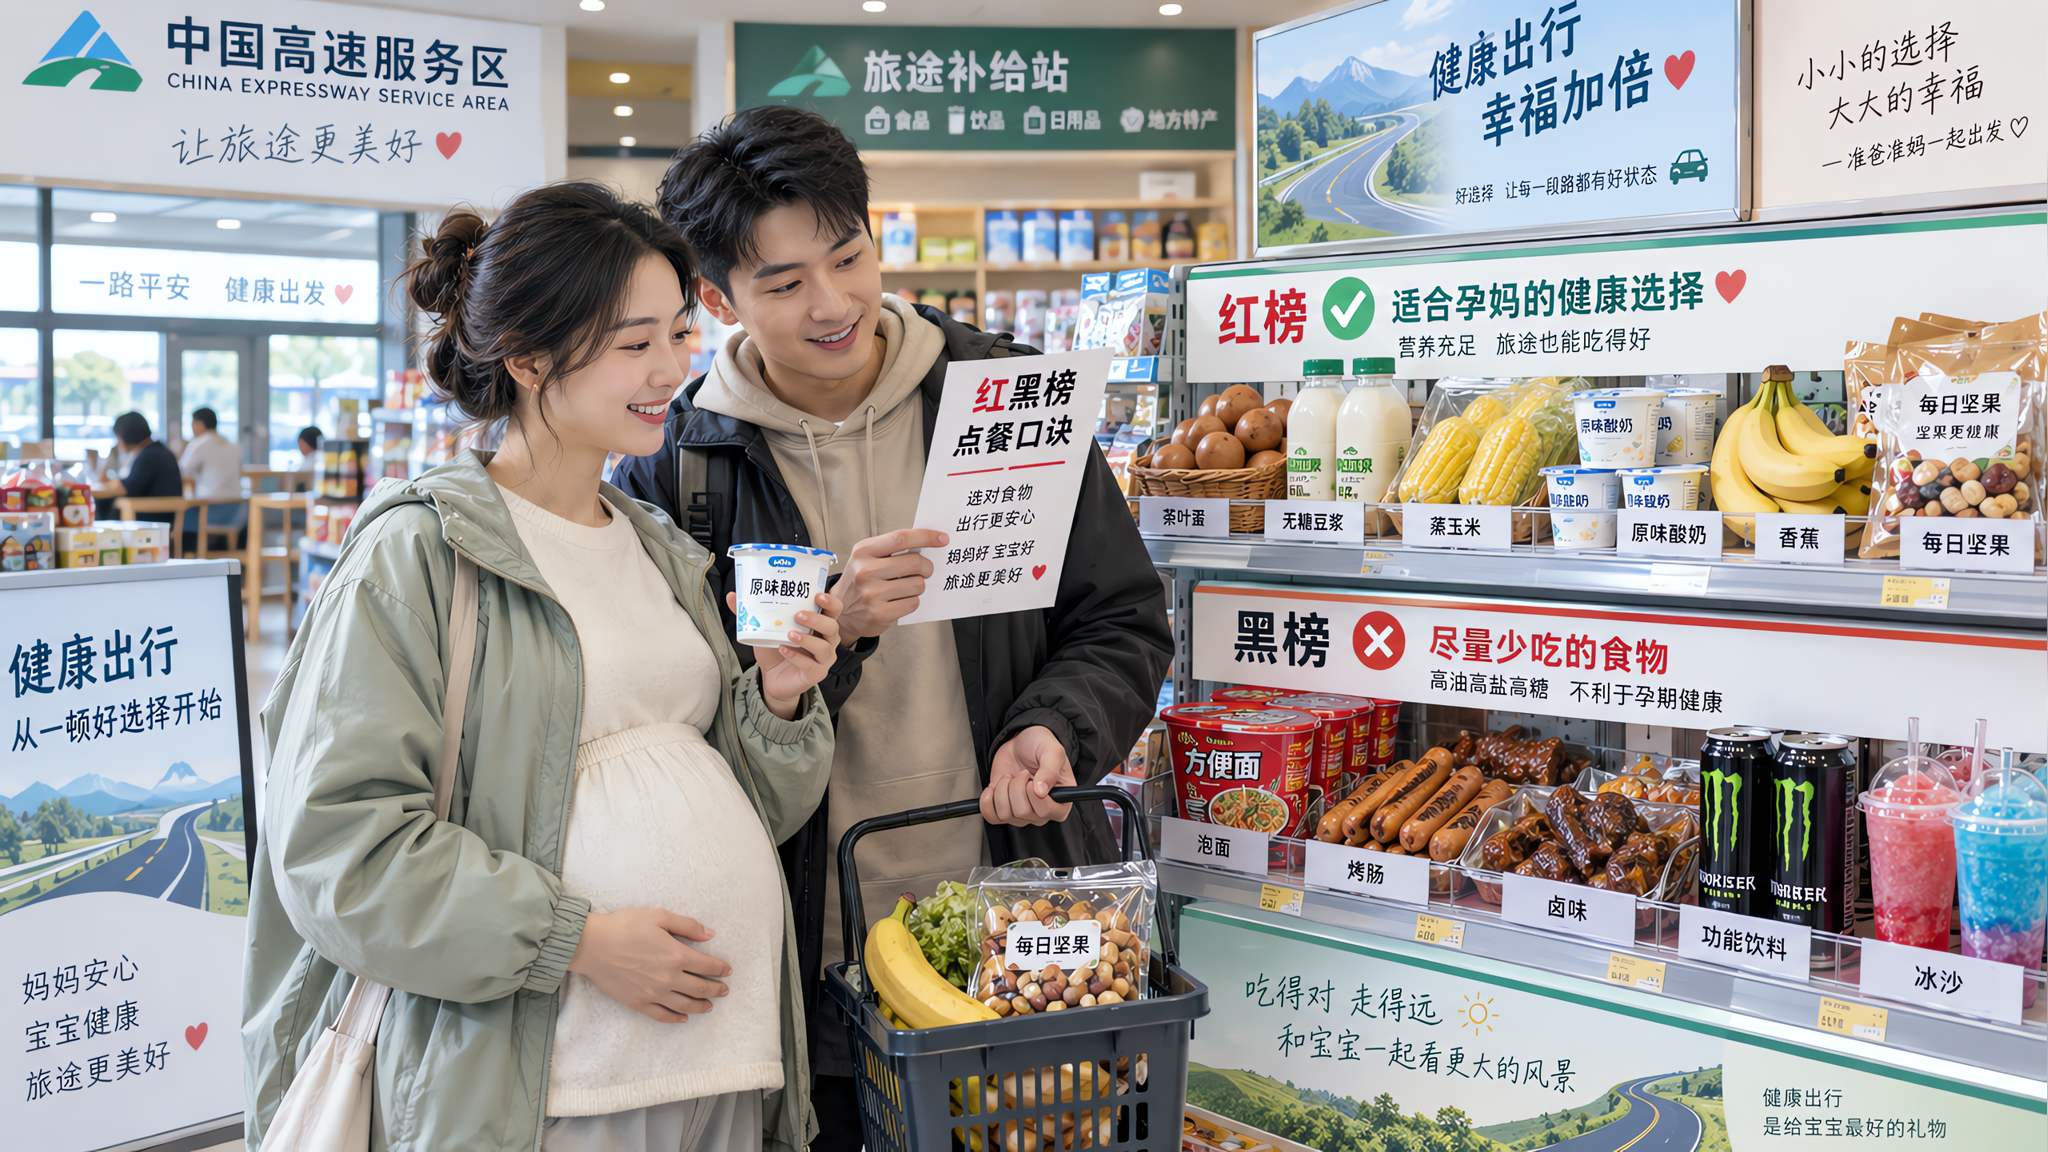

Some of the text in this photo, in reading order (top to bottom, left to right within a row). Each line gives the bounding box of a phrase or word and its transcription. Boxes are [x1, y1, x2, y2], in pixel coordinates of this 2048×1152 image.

[167, 15, 509, 89] 中国高速服务区
[1428, 0, 1582, 101] 健康出行
[1797, 20, 1960, 91] 小小的选择
[863, 50, 1070, 93] 旅途补给站
[168, 73, 508, 111] CHINA EXPRESSWAY SERVICE AREA
[1481, 48, 1653, 148] 幸福加倍
[1828, 65, 1985, 130] 大大的幸福
[894, 109, 1219, 130] 食品 饮品 日用品 地方特产
[172, 123, 422, 165] 让旅途更美好
[1506, 165, 1657, 198] 让每一段路都有好状态
[80, 271, 324, 305] 一路平安 健康出发
[1219, 271, 1703, 344] 红榜 适合孕妈的健康选择
[1399, 328, 1650, 358] 营养充足 旅途也能吃得好
[973, 369, 1077, 413] 红黑榜
[1919, 394, 2001, 415] 每日坚果
[953, 415, 1072, 457] 点餐口诀
[1163, 509, 1205, 526] 茶叶蛋
[1283, 513, 1343, 531] 无糖豆浆
[1431, 517, 1480, 536] 蒸玉米
[1632, 523, 1706, 544] 原味酸奶
[1780, 527, 1819, 549] 香蕉
[1923, 532, 2009, 556] 每日坚果
[750, 579, 809, 598] 原味酸奶
[1235, 611, 1669, 675] 黑榜 尽量少吃的食物
[9, 626, 178, 698] 健康出行
[1431, 670, 1722, 713] 高油高盐高糖 不利于孕期健康
[12, 687, 222, 752] 从一顿好选择开始
[1184, 748, 1263, 781] 方便面
[1198, 835, 1230, 857] 泡面
[1348, 860, 1383, 884] 烤肠
[1549, 895, 1586, 921] 卤味
[1016, 936, 1089, 956] 每日坚果
[1701, 925, 1787, 961] 功能饮料
[22, 954, 139, 1004] 妈妈安心
[1915, 966, 1963, 994] 冰沙
[1245, 974, 1442, 1025] 吃得对 走得远
[25, 1000, 140, 1052] 宝宝健康
[26, 1041, 171, 1102] 旅途更美好
[1277, 1023, 1577, 1094] 和宝宝一起看更大的风景
[1763, 1088, 1842, 1108] 健康出行
[1764, 1117, 1946, 1138] 是给宝宝最好的礼物
